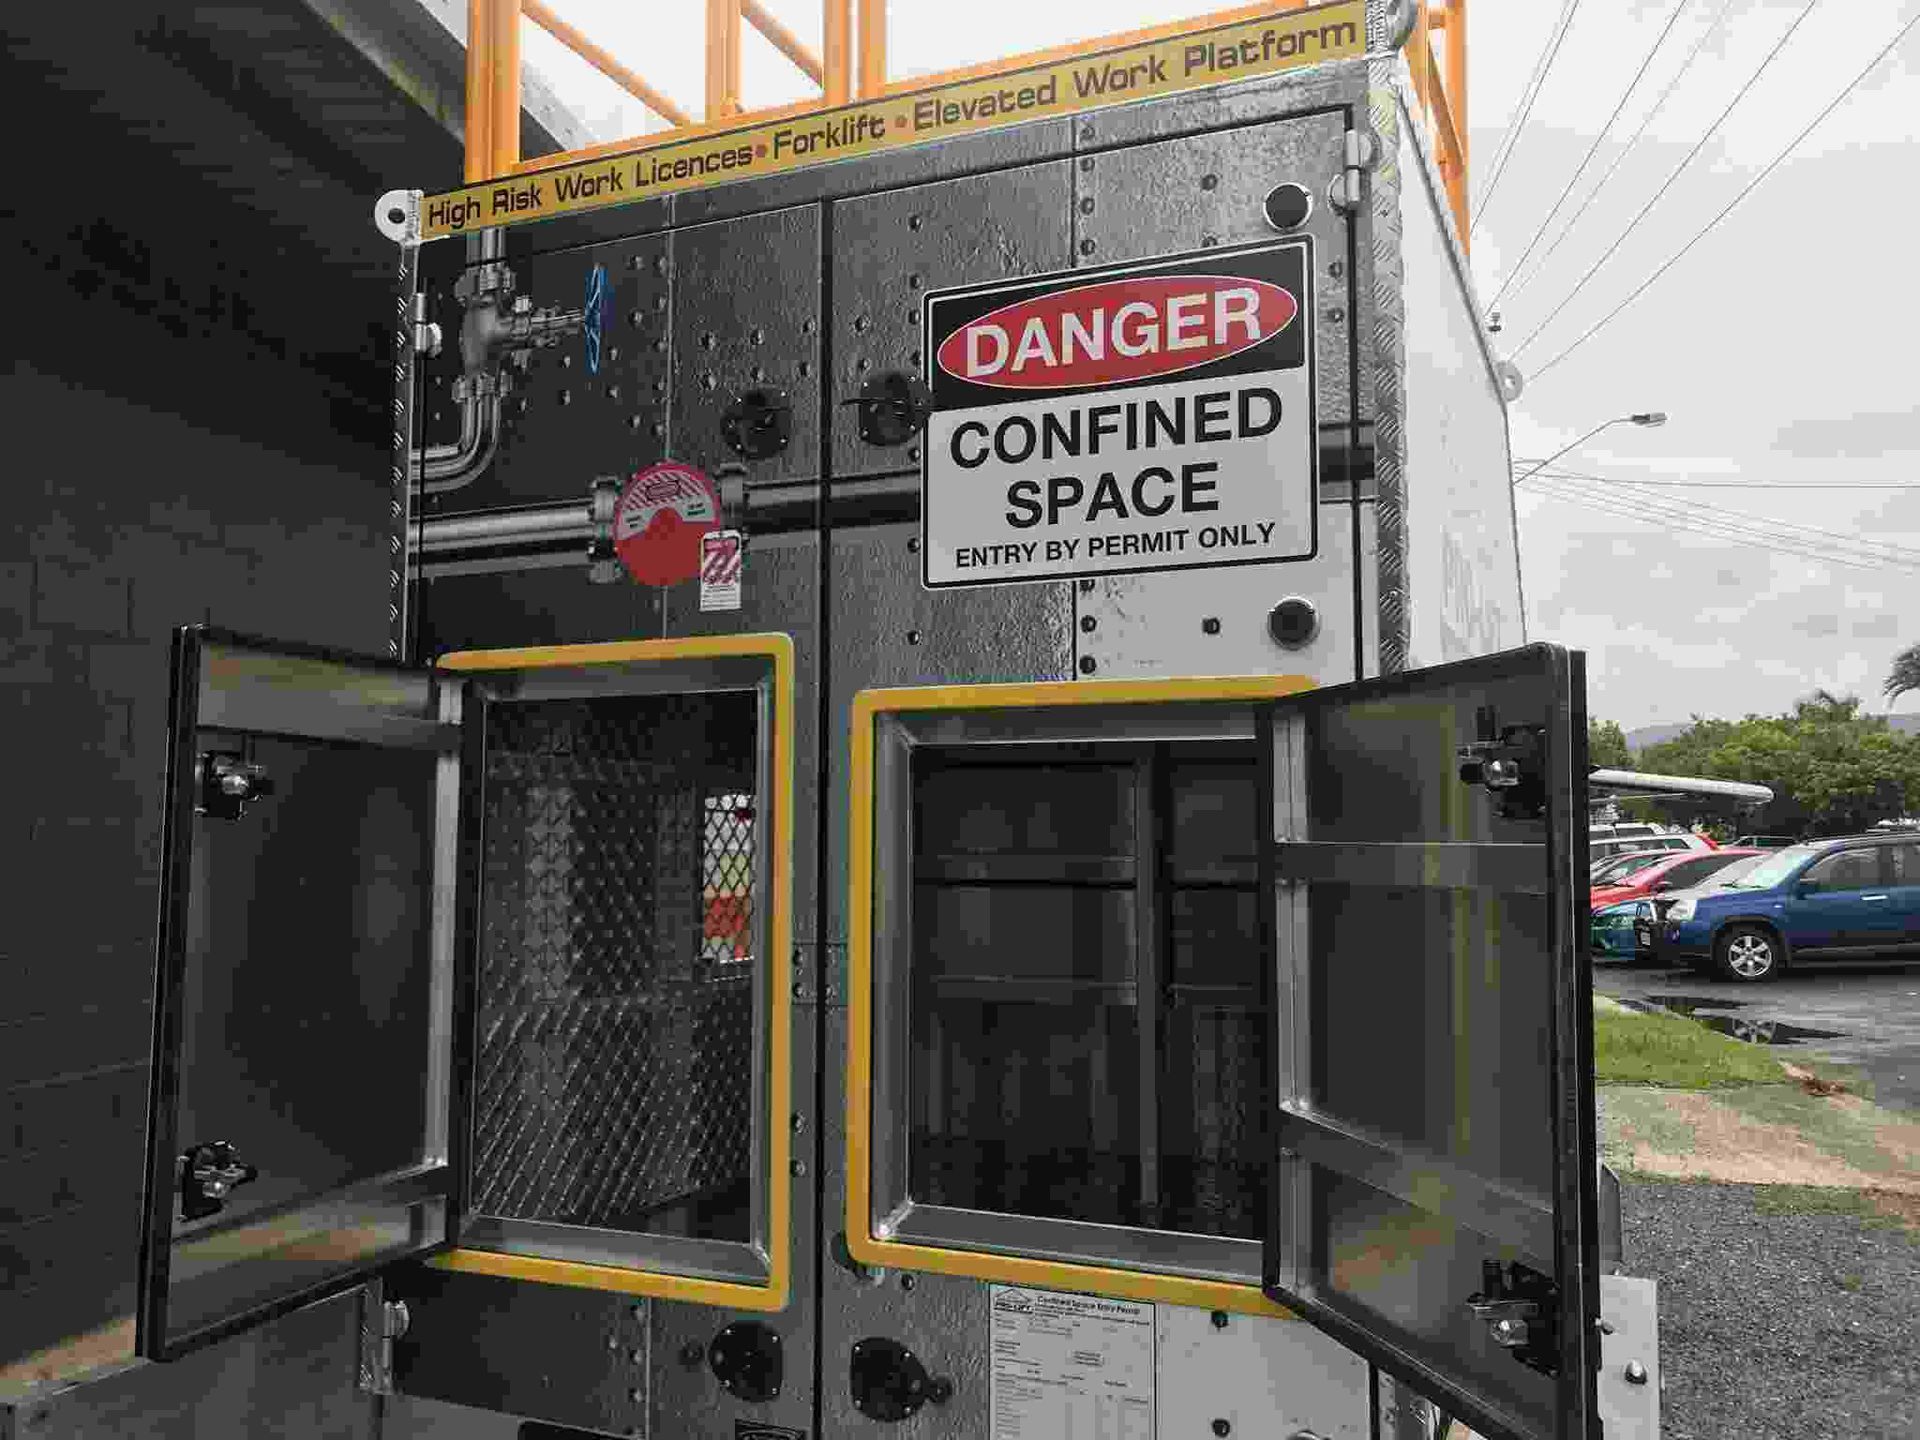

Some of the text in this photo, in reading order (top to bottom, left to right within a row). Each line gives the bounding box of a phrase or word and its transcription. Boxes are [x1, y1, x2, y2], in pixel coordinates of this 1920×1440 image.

[428, 21, 1357, 229] High Risk Work Licences Forklift Elevated Work Platform
[966, 287, 1262, 378] DANGER
[950, 387, 1282, 468] CONFINED
[1005, 462, 1219, 528] SPACE
[955, 522, 1276, 568] ENTRY BY PERMIT ONLY
